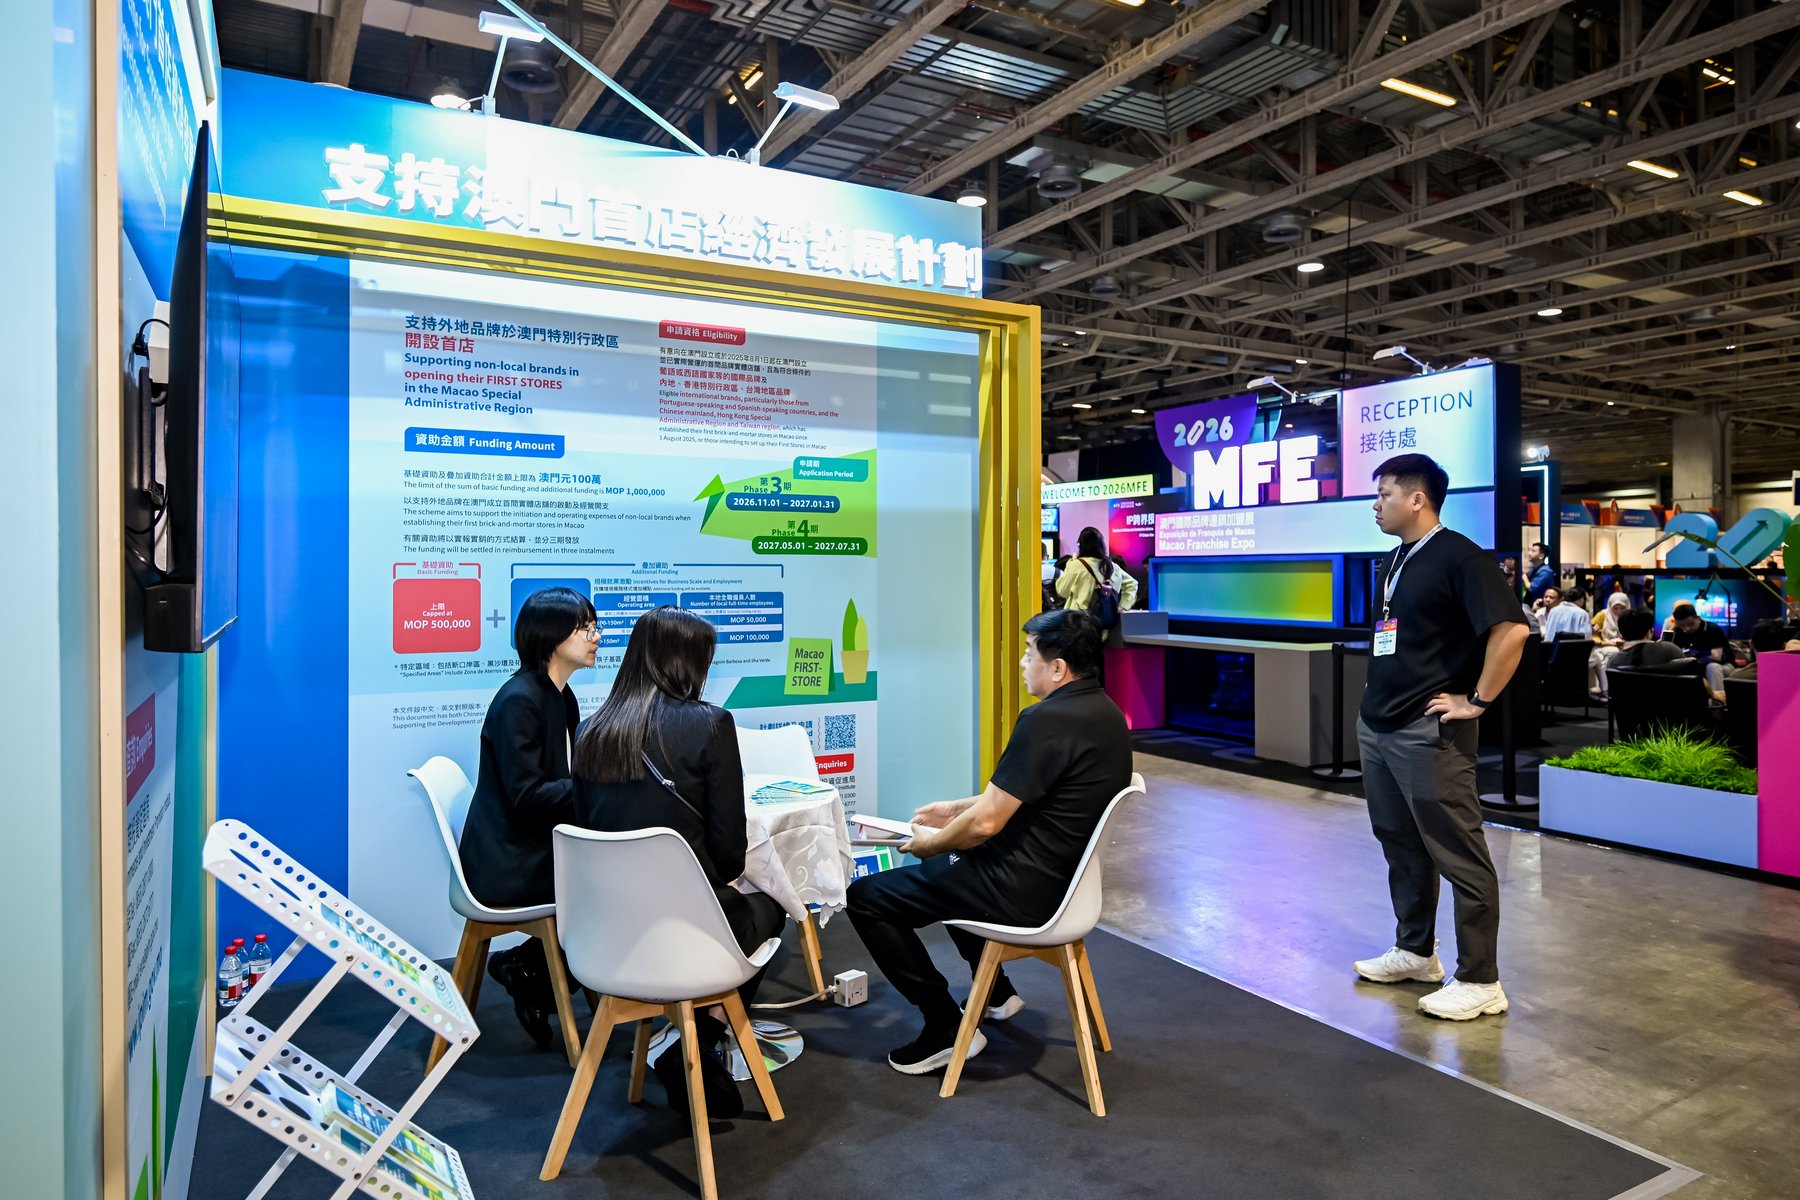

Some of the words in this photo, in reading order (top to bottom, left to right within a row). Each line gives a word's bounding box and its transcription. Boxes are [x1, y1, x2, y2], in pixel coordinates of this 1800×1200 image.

[405, 314, 619, 349] 支持外地品牌於澳門特別行政區
[666, 325, 700, 338] 申請資格
[702, 330, 738, 342] Eligibility
[405, 332, 474, 354] 開設首店
[405, 353, 472, 370] Supporting
[474, 360, 527, 372] non-local
[528, 362, 567, 375] brands
[569, 366, 579, 376] in
[404, 371, 454, 384] opening
[456, 372, 484, 384] their
[486, 374, 518, 386] FIRST
[520, 377, 562, 389] STORES
[405, 383, 416, 393] in
[418, 384, 439, 394] the
[440, 385, 479, 397] Macao
[481, 388, 522, 400] Special
[659, 389, 679, 399] Eligible
[680, 391, 719, 400] international
[720, 394, 743, 403] brands,
[744, 396, 777, 406] particularly
[405, 397, 492, 411] Administrative
[493, 402, 533, 415] Region
[659, 399, 724, 411] Portuguese-speaking
[737, 404, 788, 415] Spanish-speaking
[789, 408, 817, 417] countries,
[1361, 390, 1472, 424] RECEPTION
[659, 408, 684, 416] Chinese
[685, 410, 716, 419] mainland,
[716, 411, 733, 420] Hong
[734, 412, 750, 421] Kong
[750, 413, 771, 422] Special
[1174, 416, 1234, 447] 2026
[416, 432, 464, 447] 資助金額
[469, 437, 512, 450] Funding
[514, 440, 556, 450] Amount
[1360, 427, 1417, 454] 接待處
[538, 472, 602, 485] 澳門元100萬
[799, 469, 834, 477] Application
[1193, 434, 1319, 510] MFE
[500, 484, 525, 492] funding
[574, 486, 598, 495] funding
[626, 488, 665, 497] 1,000,000
[744, 485, 768, 493] Phase
[1042, 486, 1085, 500] WELCOME
[1088, 485, 1100, 496] TO
[1103, 480, 1148, 495] 2026MFE
[733, 498, 780, 507] 2026.11.01
[790, 500, 835, 508] 2027.01.31
[557, 512, 587, 520] operating
[418, 546, 446, 554] funding
[758, 542, 805, 550] 2027.05.01
[814, 542, 860, 550] 2027.07.31
[1159, 540, 1185, 550] Macao
[1186, 538, 1229, 550] Franchise
[1232, 537, 1255, 550] Expo
[404, 620, 428, 629] MOP
[431, 620, 471, 630] 500,000
[794, 648, 824, 659] Macao
[794, 662, 822, 672] FIRST-
[792, 676, 822, 687] STORE
[816, 760, 847, 770] Enquiries
